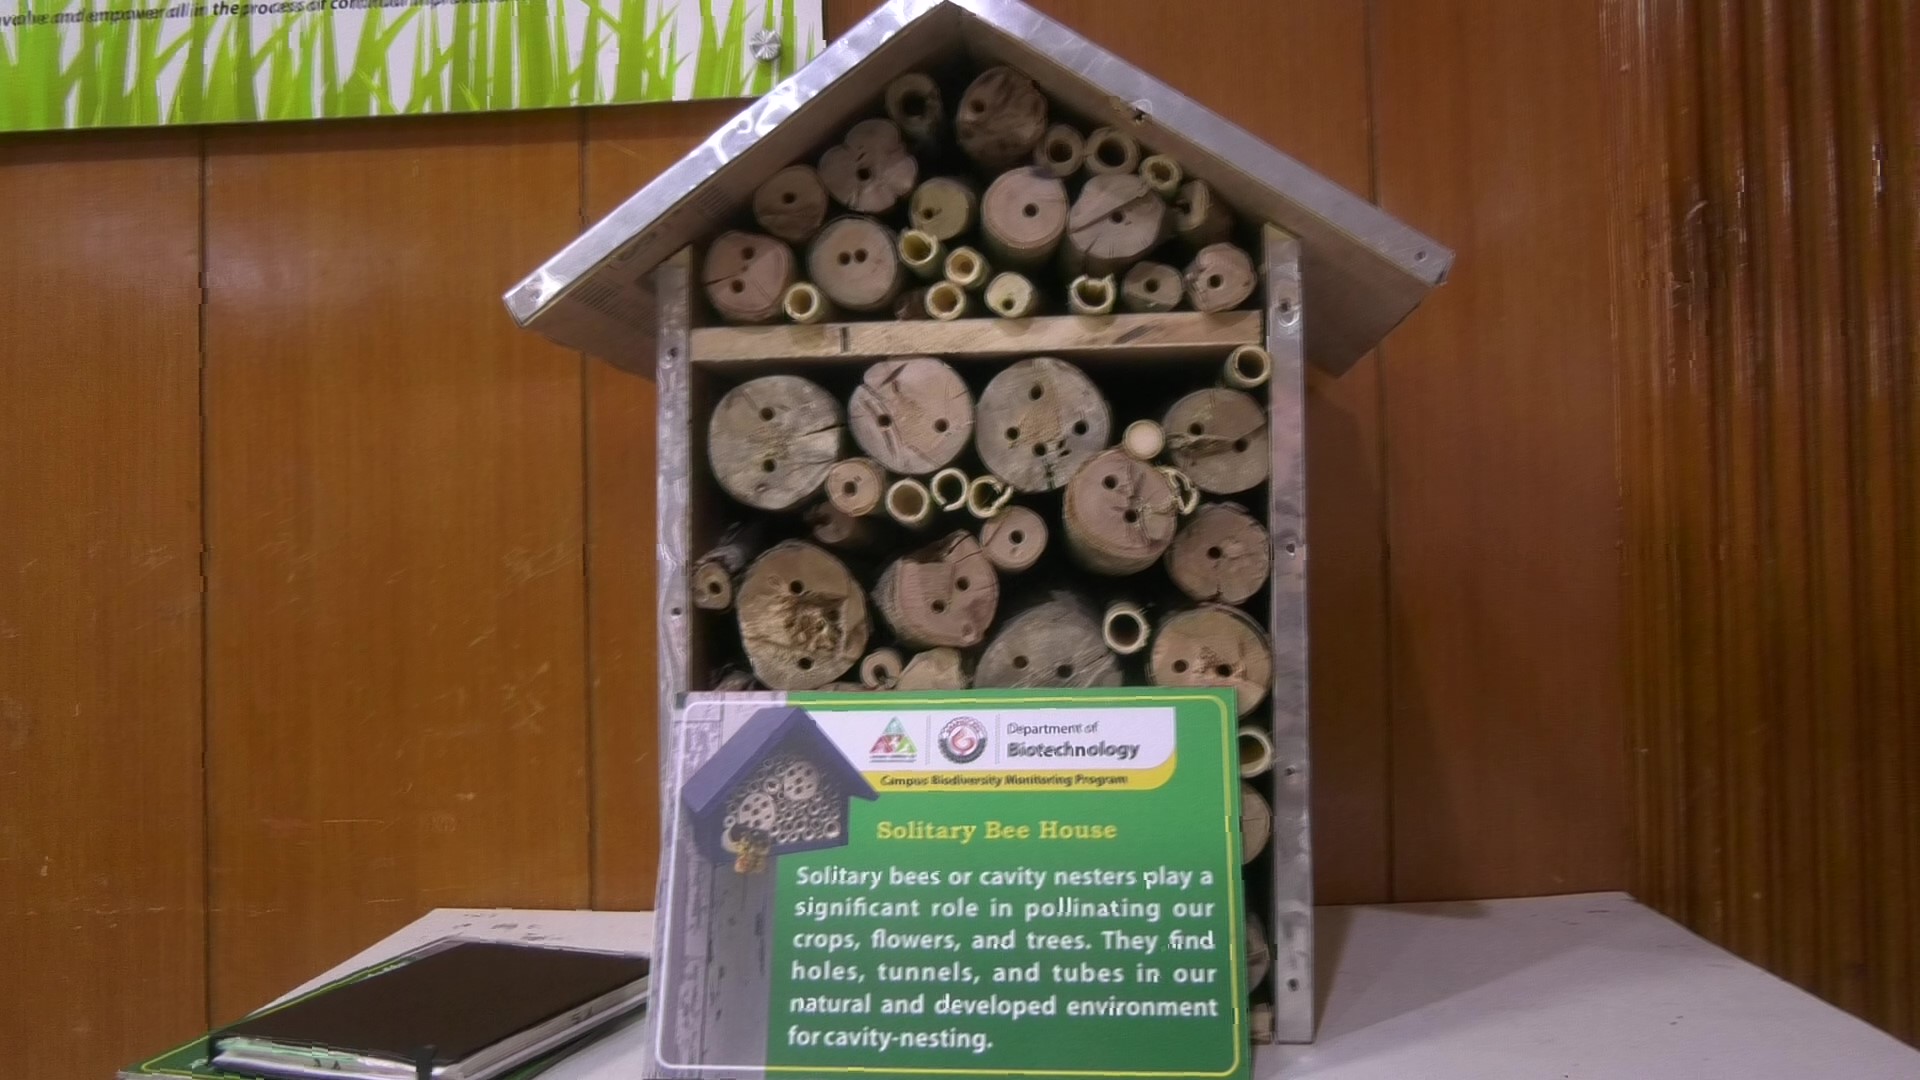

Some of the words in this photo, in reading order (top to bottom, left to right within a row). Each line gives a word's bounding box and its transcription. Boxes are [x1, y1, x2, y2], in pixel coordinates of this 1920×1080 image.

[213, 0, 239, 15] the
[1007, 722, 1081, 736] Department
[1084, 721, 1098, 734] of
[1007, 740, 1140, 760] Biotechnology
[880, 774, 928, 787] Campus
[930, 774, 1002, 787] Biodiversity
[1004, 773, 1073, 786] Monitoring
[1075, 773, 1129, 786] Program
[876, 820, 977, 845] Solitary
[984, 820, 1031, 840] Bee
[1038, 820, 1118, 840] House
[796, 865, 883, 890] Solitary
[889, 866, 941, 886] bees
[947, 870, 973, 886] or
[978, 866, 1047, 890] cavity
[1054, 869, 1137, 886] nesters
[1143, 865, 1193, 890] play
[1200, 870, 1214, 886] a
[794, 896, 920, 921] significant
[931, 897, 979, 918] role
[990, 898, 1013, 918] in
[1025, 896, 1161, 922] pollinating
[1172, 902, 1215, 918] our
[793, 932, 861, 953] crops,
[871, 928, 961, 952] flowers,
[971, 928, 1016, 950] and
[1026, 932, 1092, 950] trees.
[1101, 930, 1158, 955] They
[1168, 930, 1215, 950] find
[791, 960, 865, 983] holes,
[877, 961, 980, 984] tunnels,
[992, 962, 1040, 982] and
[1052, 962, 1125, 982] tubes
[1136, 962, 1160, 983] in
[1173, 967, 1218, 983] our
[789, 993, 872, 1013] natural
[880, 994, 925, 1014] and
[934, 993, 1057, 1020] developed
[1066, 995, 1219, 1017] environment
[787, 1025, 821, 1046] for
[823, 1026, 993, 1053] cavity-nesting.
